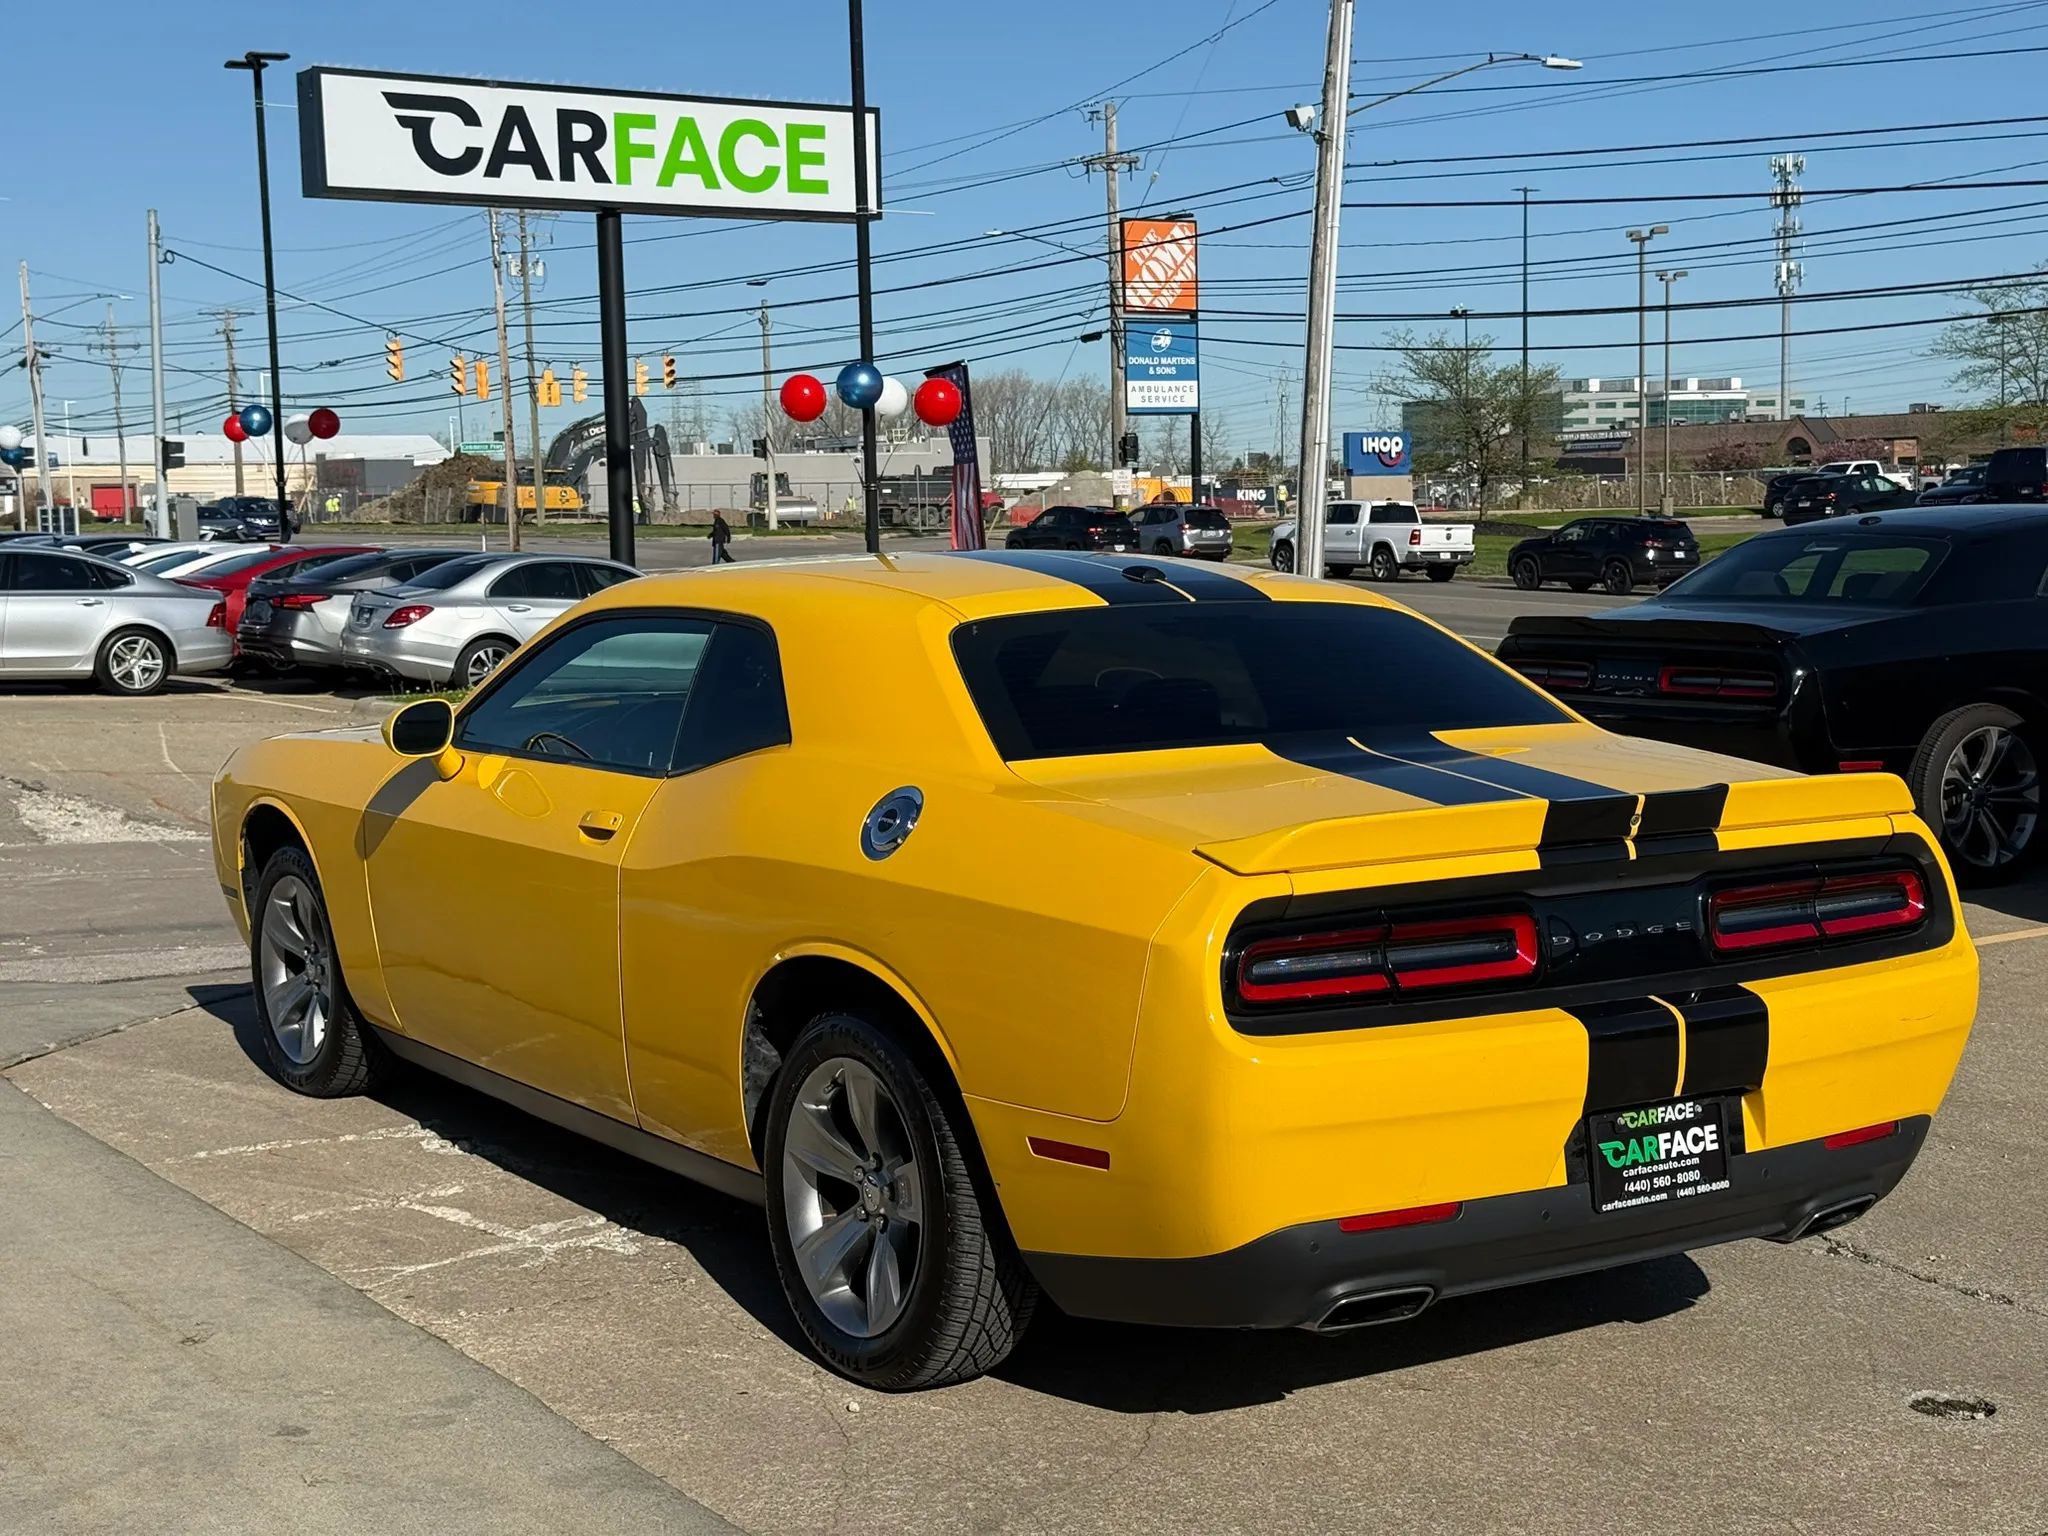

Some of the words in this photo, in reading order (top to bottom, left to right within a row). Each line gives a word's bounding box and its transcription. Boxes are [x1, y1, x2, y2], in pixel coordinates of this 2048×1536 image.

[380, 91, 829, 195] CARFACE
[1128, 357, 1159, 365] DONALD
[1161, 357, 1196, 365] MARTENS
[1149, 366, 1155, 375] &
[1156, 366, 1177, 375] SONS
[1131, 385, 1194, 393] AMBULANCE
[1141, 395, 1185, 403] SERVICE
[1236, 489, 1267, 501] KING
[1552, 921, 1692, 946] DODGE
[1622, 1101, 1695, 1129] CARFACE
[1598, 1124, 1720, 1169] CARFACE
[1622, 1157, 1700, 1178] carfaceauto.com
[1624, 1179, 1651, 1193] (440)
[1653, 1170, 1701, 1189] 560-8080
[1601, 1191, 1668, 1212] carfaceauto.com
